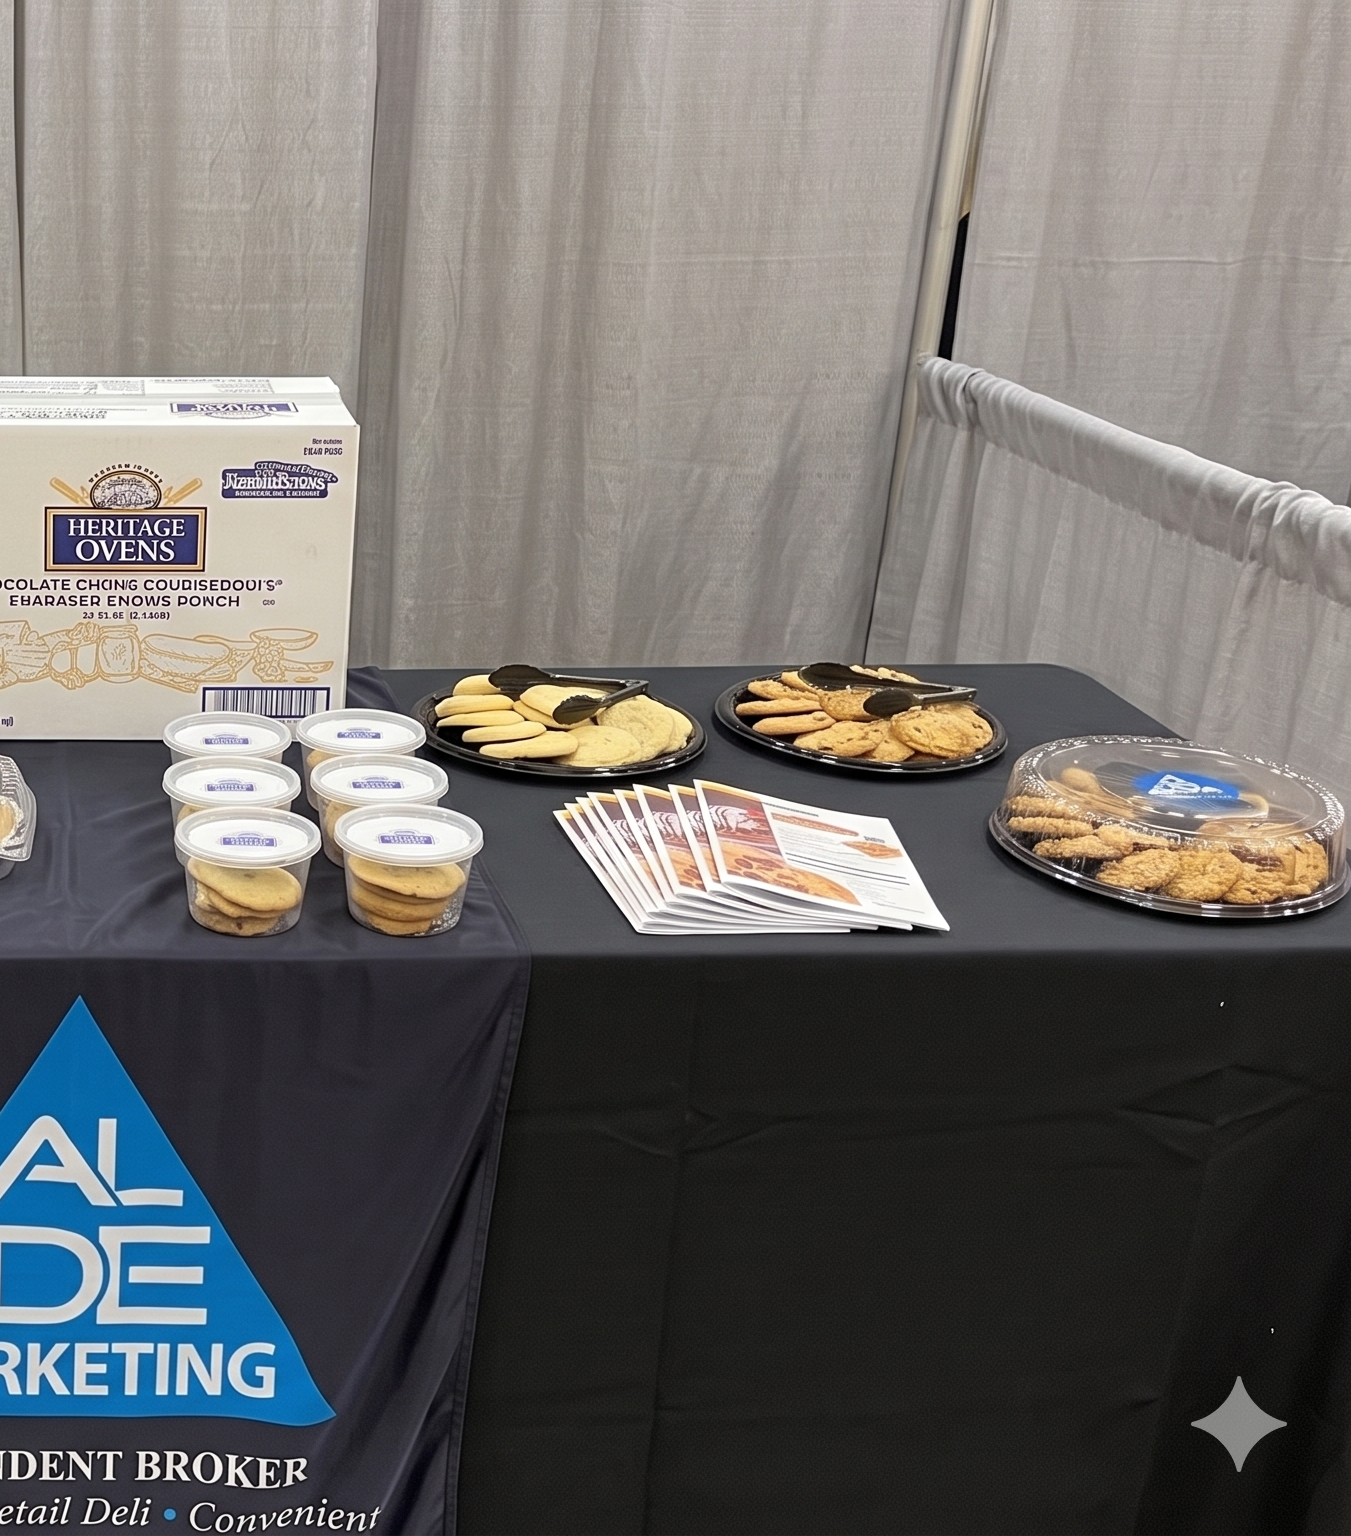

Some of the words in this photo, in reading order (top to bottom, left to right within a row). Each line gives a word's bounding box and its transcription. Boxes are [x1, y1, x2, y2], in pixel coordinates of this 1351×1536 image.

[67, 518, 186, 537] HERITAGE
[75, 539, 175, 562] OVENS
[107, 595, 171, 607] ENOWS
[134, 1450, 308, 1490] BROKER
[80, 1497, 152, 1527] Deli
[189, 1498, 382, 1533] Convenient
